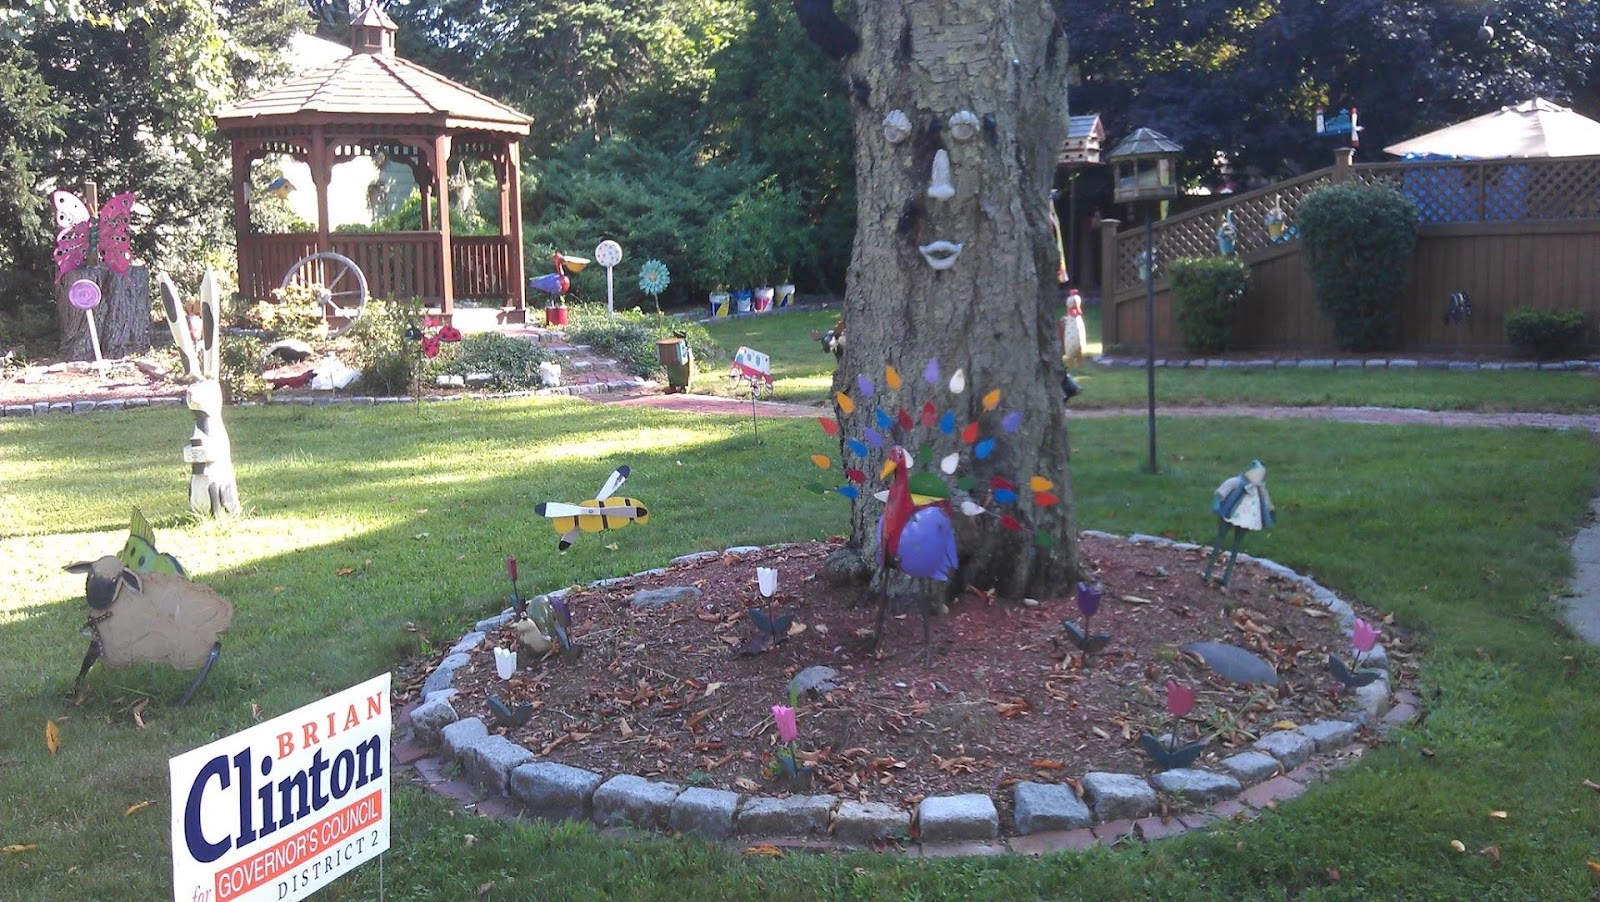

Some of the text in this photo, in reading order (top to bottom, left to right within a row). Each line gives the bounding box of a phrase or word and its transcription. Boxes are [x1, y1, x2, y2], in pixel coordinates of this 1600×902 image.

[276, 691, 383, 760] BRIAN
[184, 734, 383, 863] Clinton
[218, 831, 319, 897] GOVERNOR'S
[321, 801, 379, 845] COUNCIL
[278, 830, 379, 900] DISTRICT 2
